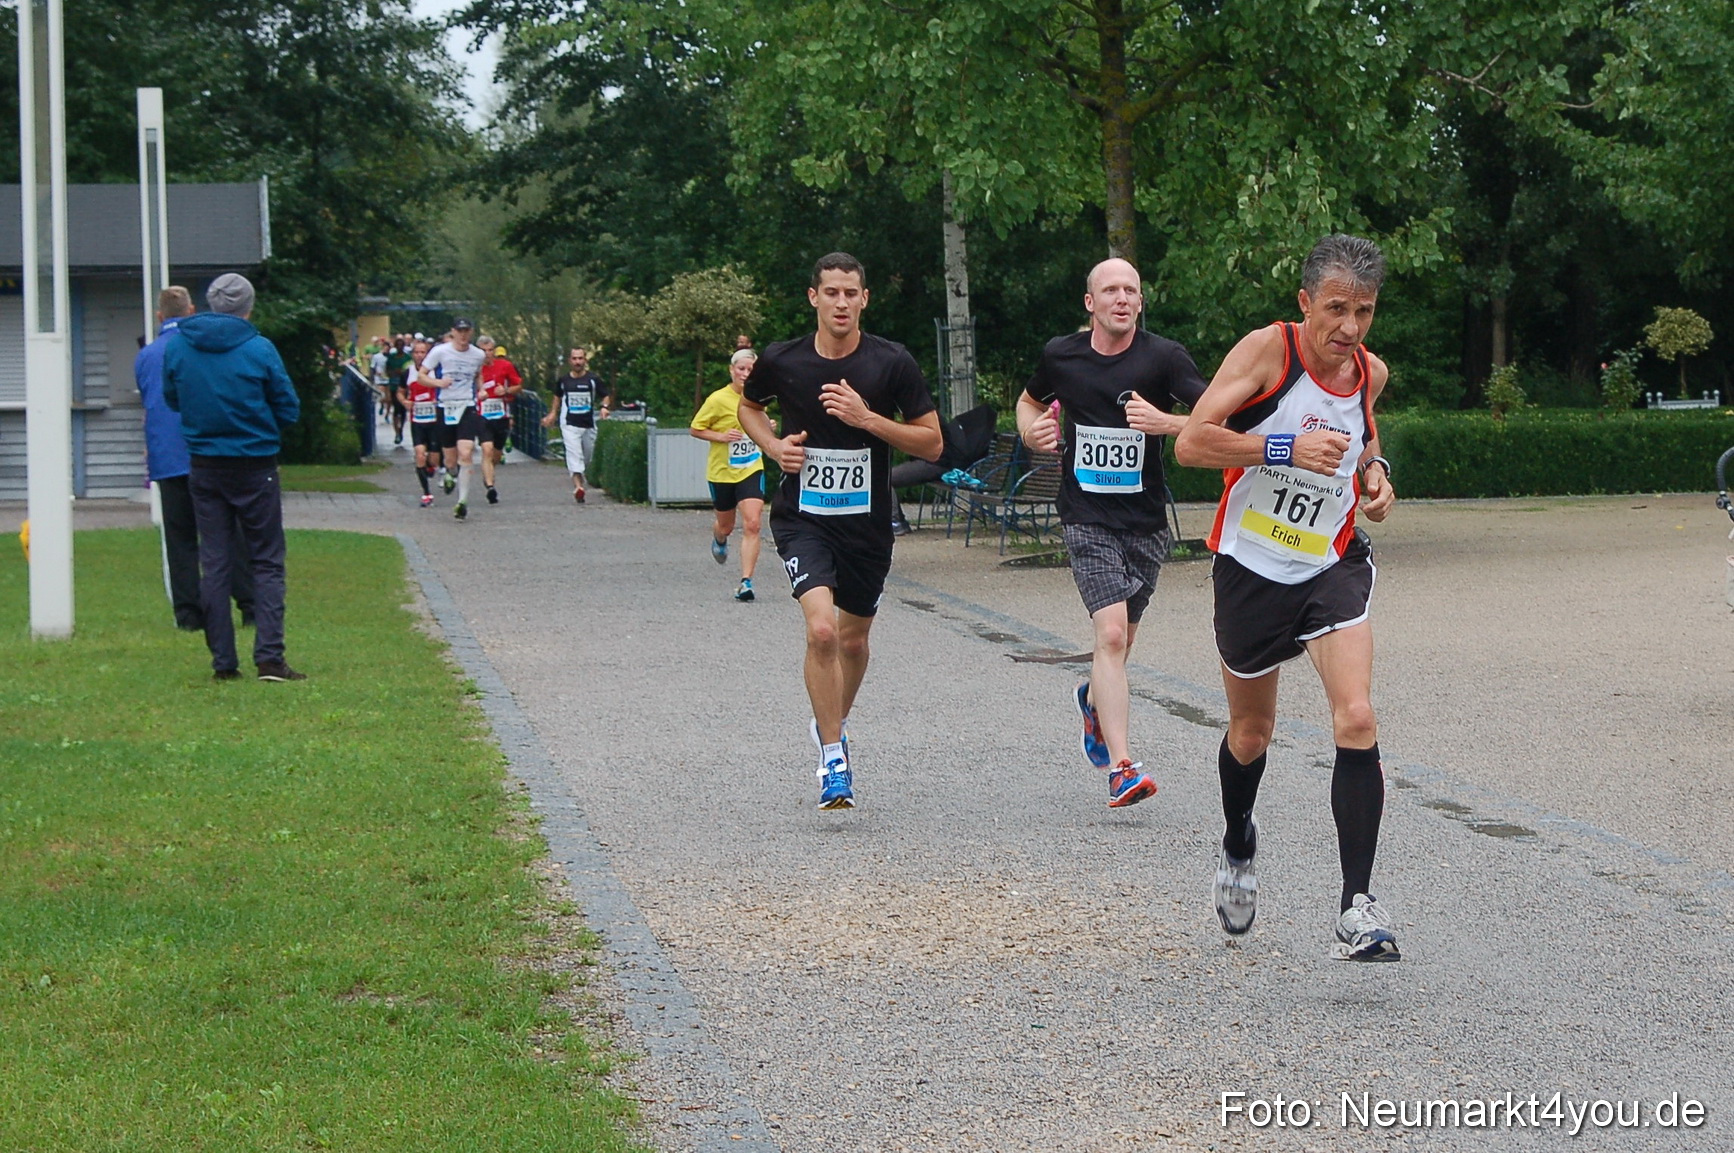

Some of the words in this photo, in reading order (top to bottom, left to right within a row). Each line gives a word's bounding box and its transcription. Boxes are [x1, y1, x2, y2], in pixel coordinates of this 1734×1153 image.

[1077, 431, 1098, 441] PARTL
[1100, 434, 1133, 442] Neumarkt
[1082, 443, 1139, 468] 3039
[807, 464, 864, 489] 2878
[1095, 473, 1121, 484] Silvio
[1259, 466, 1291, 484] PARTL
[1292, 477, 1334, 496] Neumarkt
[819, 495, 850, 506] Tobias
[1272, 487, 1325, 528] 161
[1271, 525, 1301, 547] Erich
